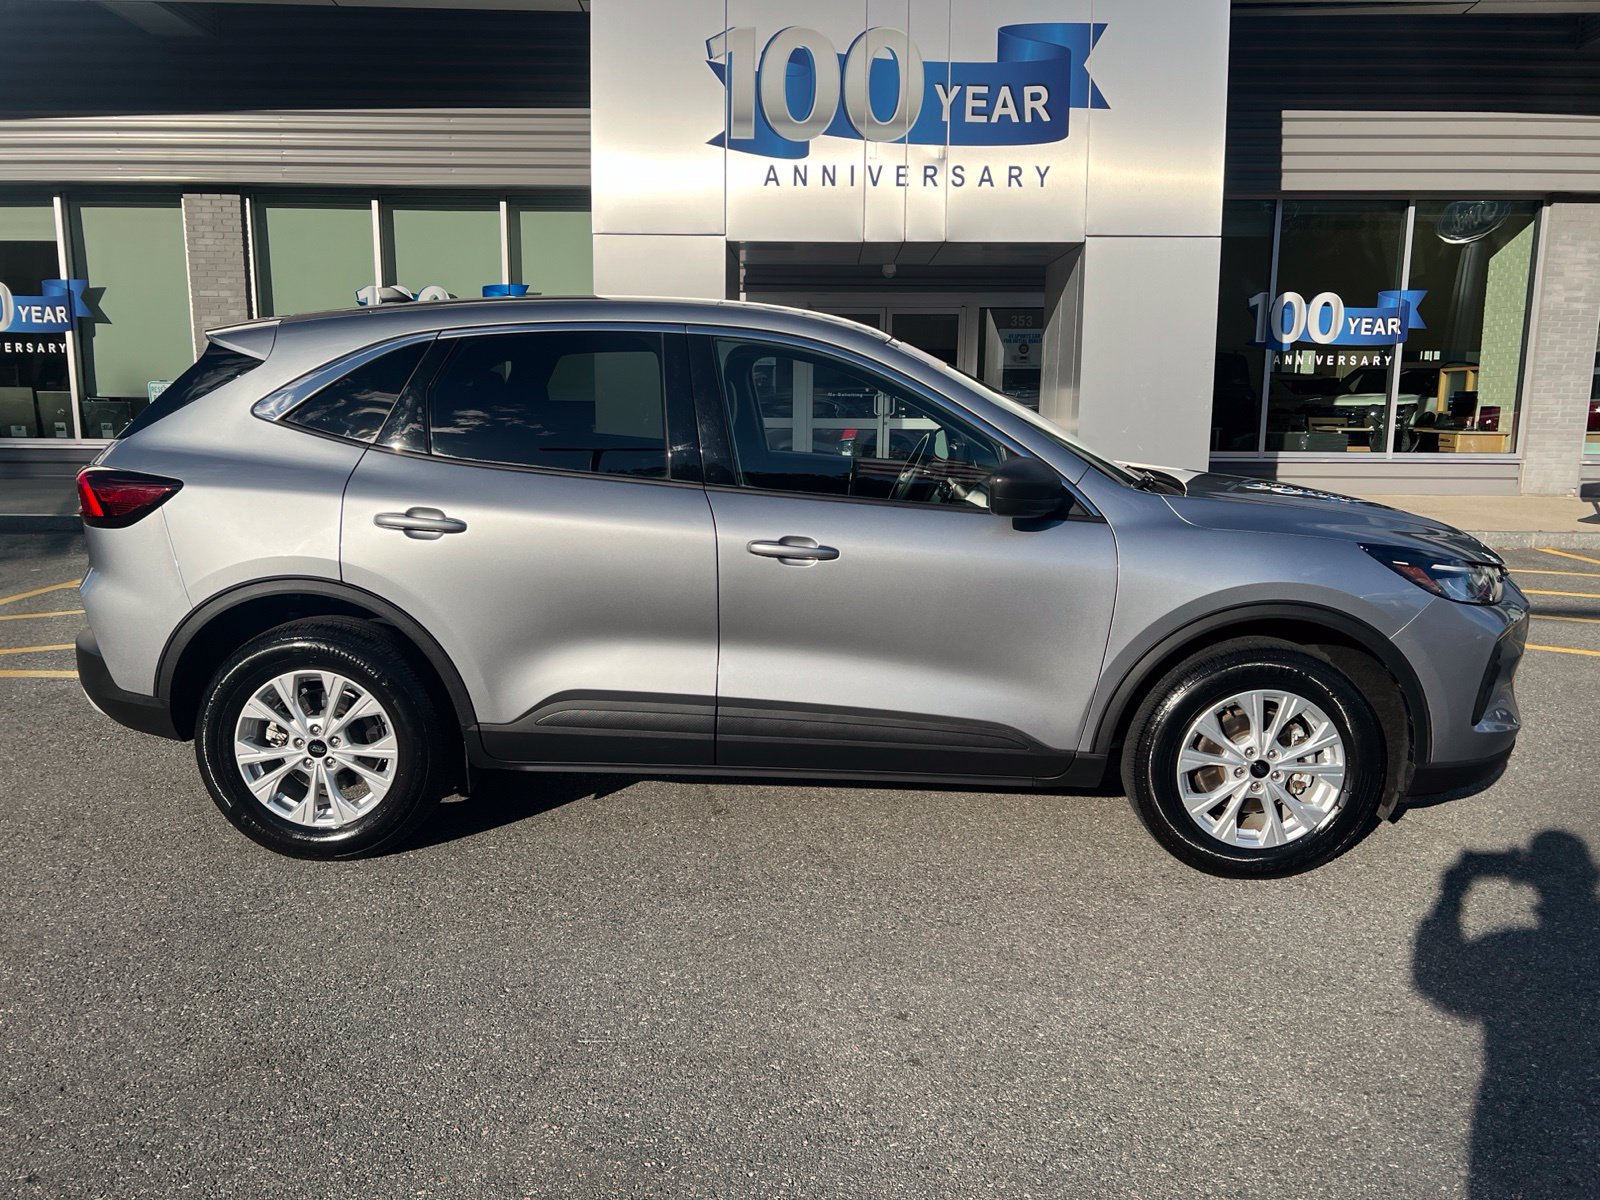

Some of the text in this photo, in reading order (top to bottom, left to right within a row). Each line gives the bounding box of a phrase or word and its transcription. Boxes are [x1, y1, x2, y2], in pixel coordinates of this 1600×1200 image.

[705, 25, 1051, 143] 100 YEAR
[763, 164, 1051, 188] ANNIVERSARY
[17, 305, 68, 323] YEAR
[1010, 315, 1033, 327] 353
[1249, 291, 1401, 344] 100 YEAR
[0, 342, 66, 353] ERSARY
[1273, 353, 1393, 367] ANNIVERSARY
